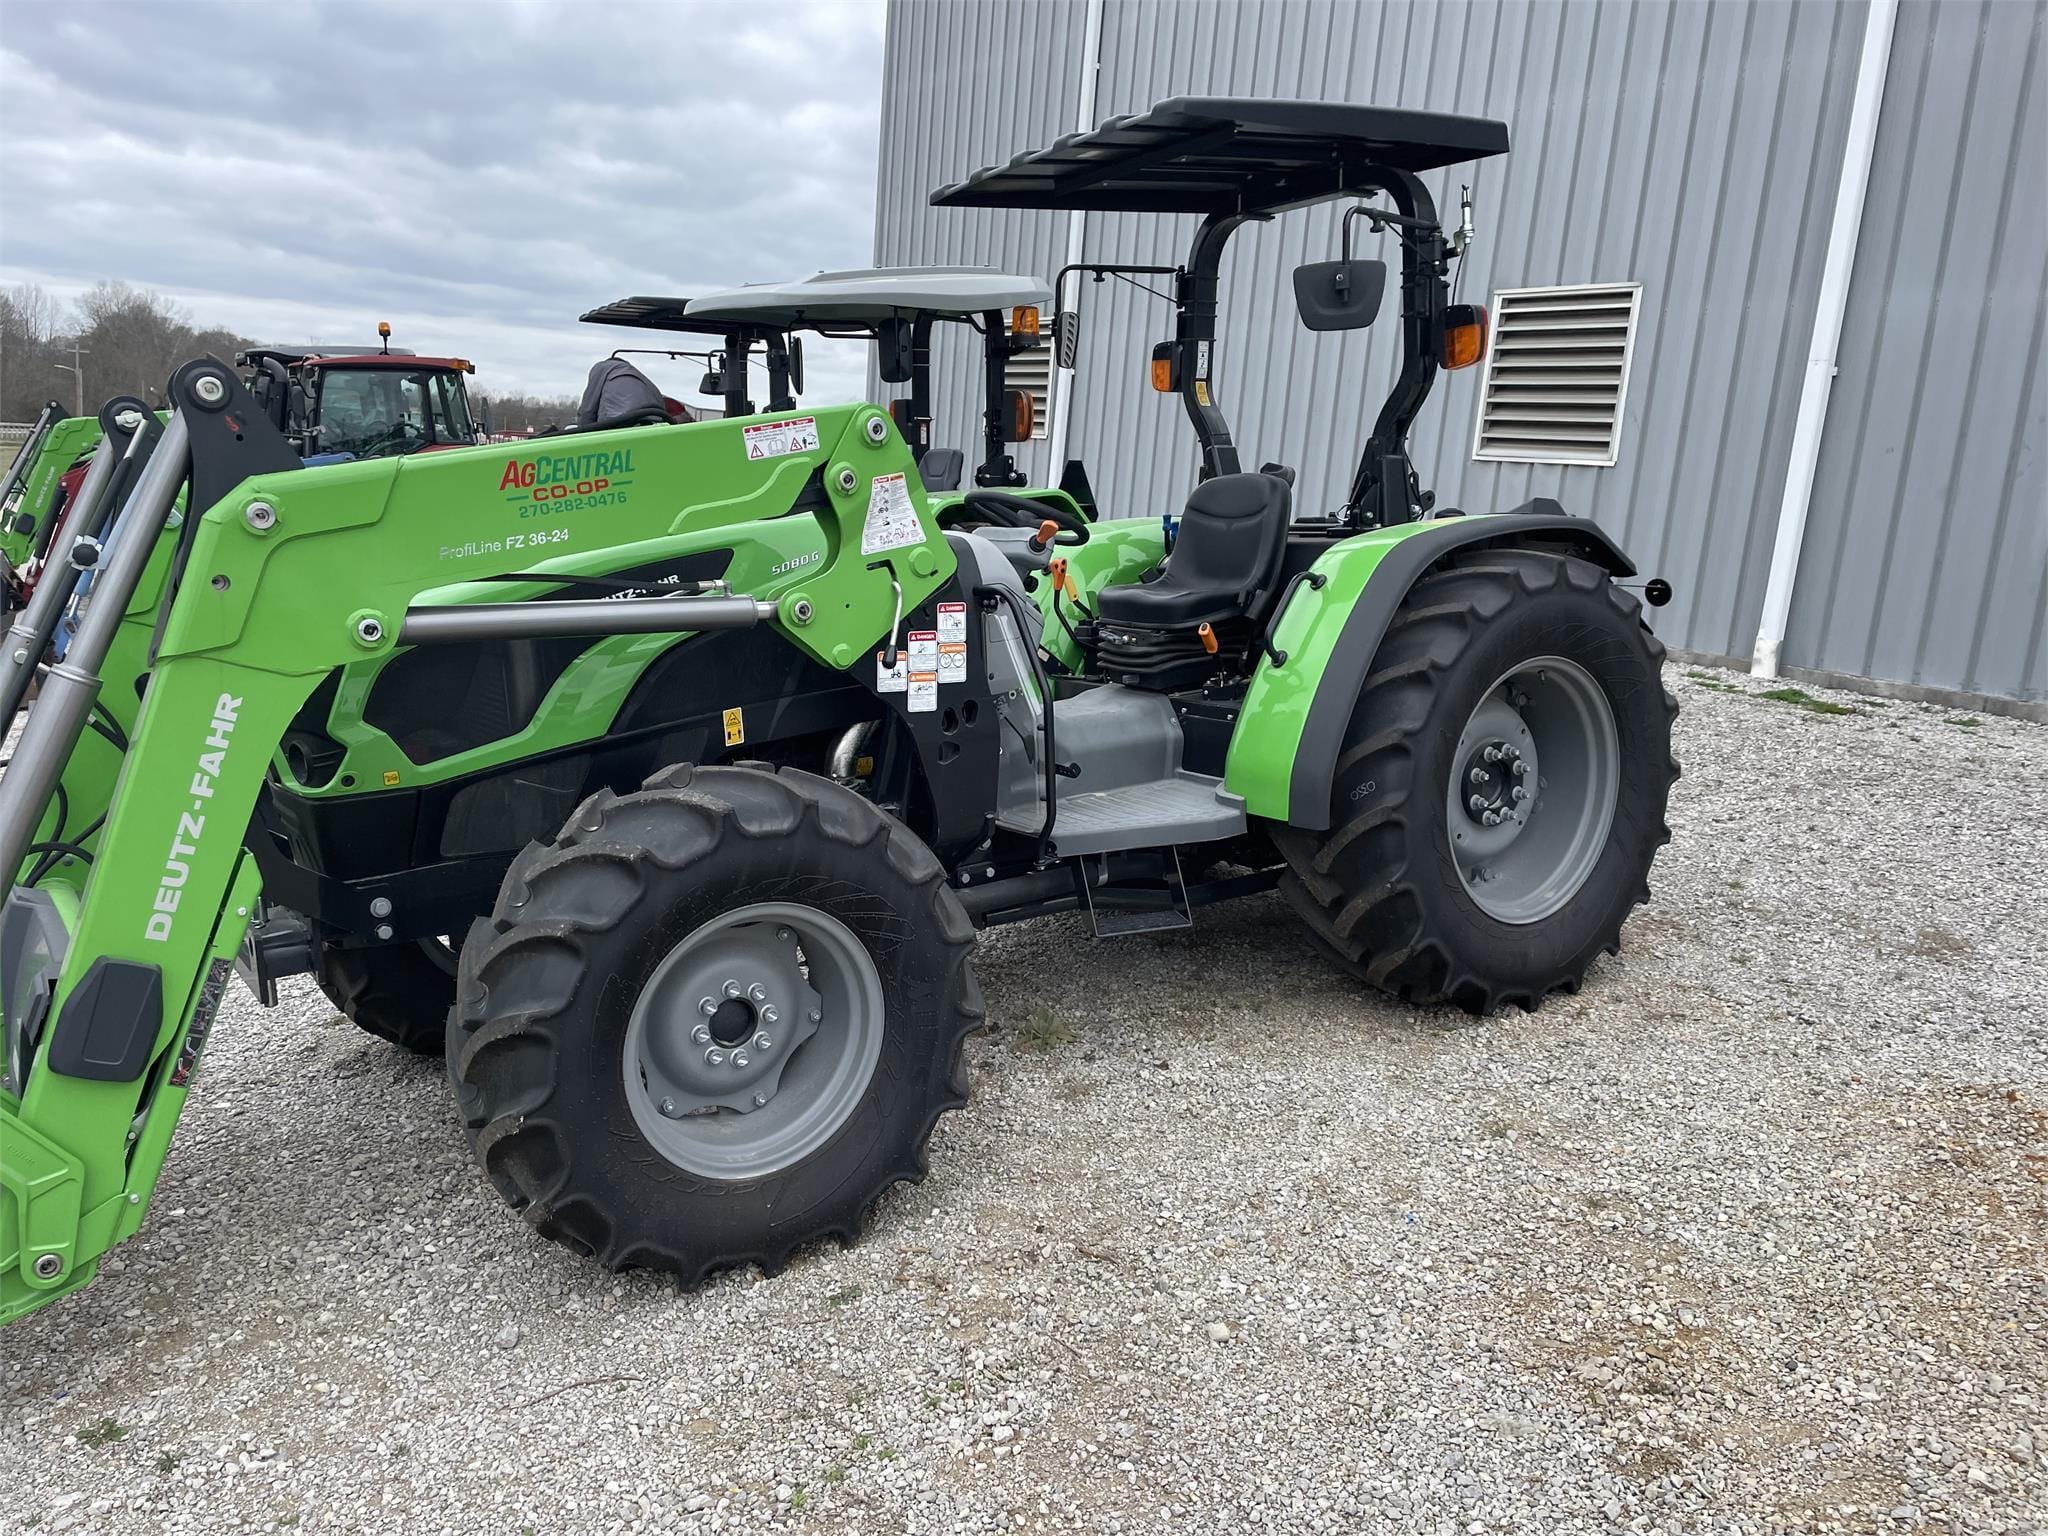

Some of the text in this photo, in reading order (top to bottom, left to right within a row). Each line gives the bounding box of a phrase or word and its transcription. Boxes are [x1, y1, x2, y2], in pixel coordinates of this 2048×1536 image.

[532, 478, 609, 502] CO-OP
[519, 491, 627, 518] 270-282-0476
[439, 528, 569, 560] ProfiLine FZ 36-24
[772, 550, 819, 575] 5080 G
[144, 692, 243, 942] DEUTZ-FAHR
